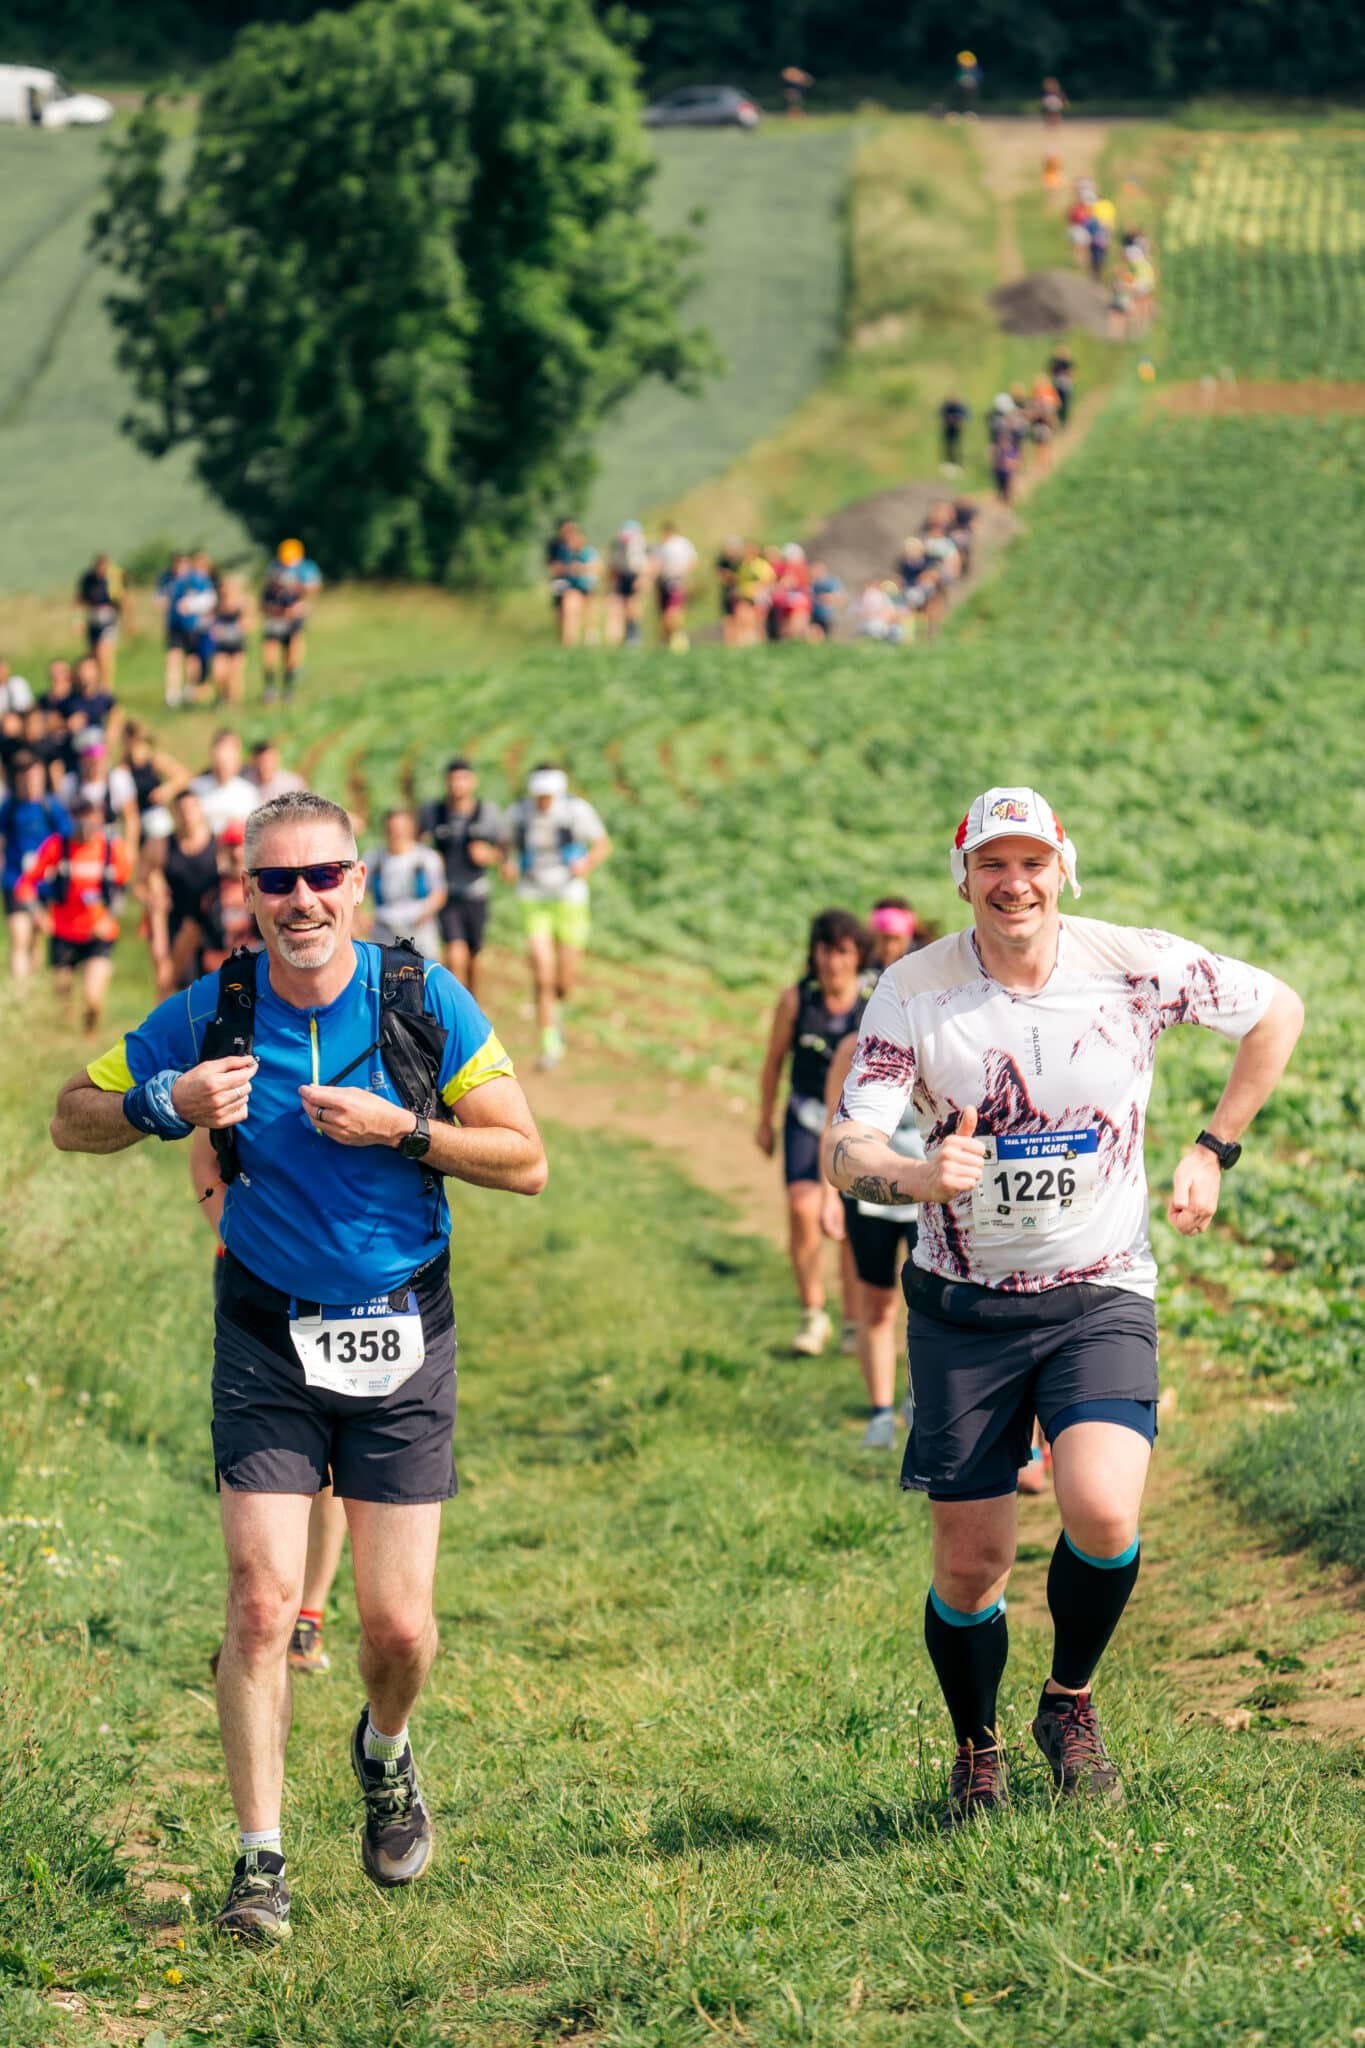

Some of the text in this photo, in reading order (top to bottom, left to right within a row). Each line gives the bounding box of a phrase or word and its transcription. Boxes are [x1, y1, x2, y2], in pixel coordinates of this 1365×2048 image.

[1032, 1025, 1043, 1076] SALOMON
[1025, 1143, 1068, 1155] 18 KMS
[994, 1167, 1076, 1202] 1226
[350, 1306, 364, 1316] 18
[315, 1329, 401, 1364] 1358
